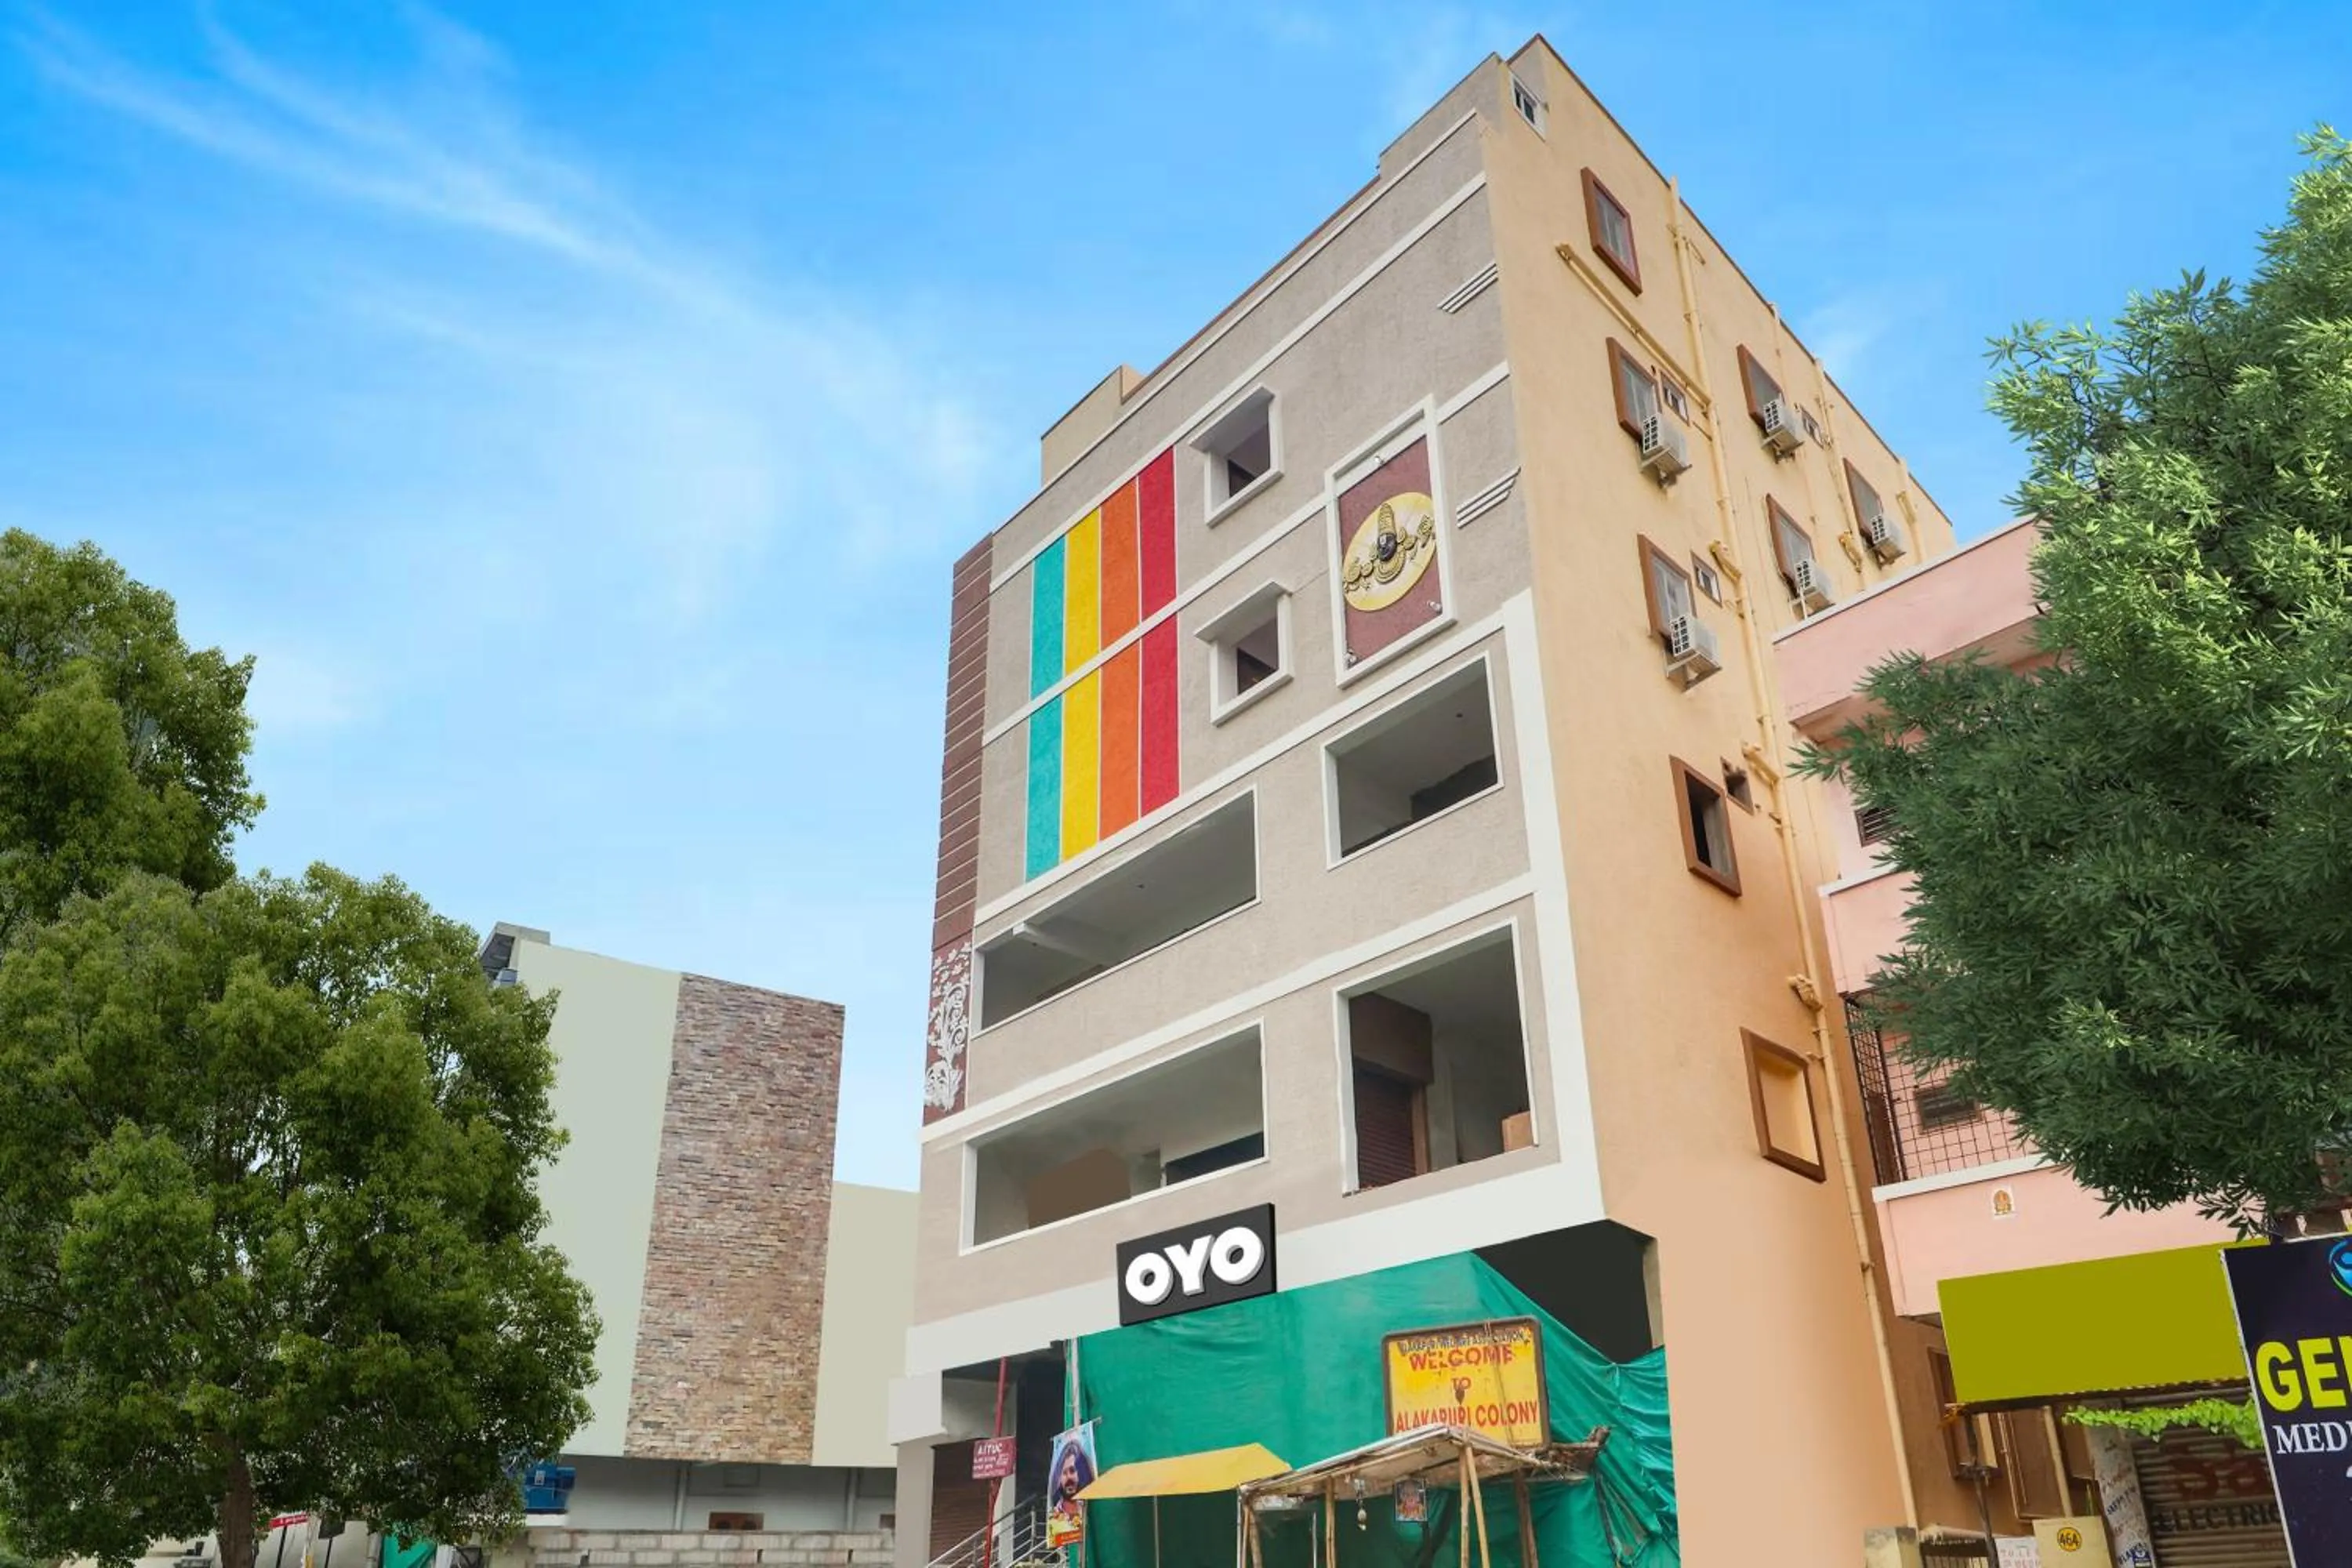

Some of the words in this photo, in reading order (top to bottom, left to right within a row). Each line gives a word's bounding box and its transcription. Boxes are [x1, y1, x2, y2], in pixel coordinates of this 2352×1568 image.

[1125, 1226, 1265, 1305] OYO
[1410, 1344, 1512, 1371] WELCOME
[1451, 1377, 1471, 1391] TO
[1475, 1401, 1537, 1428] COLONY
[2273, 1421, 2352, 1454] MED
